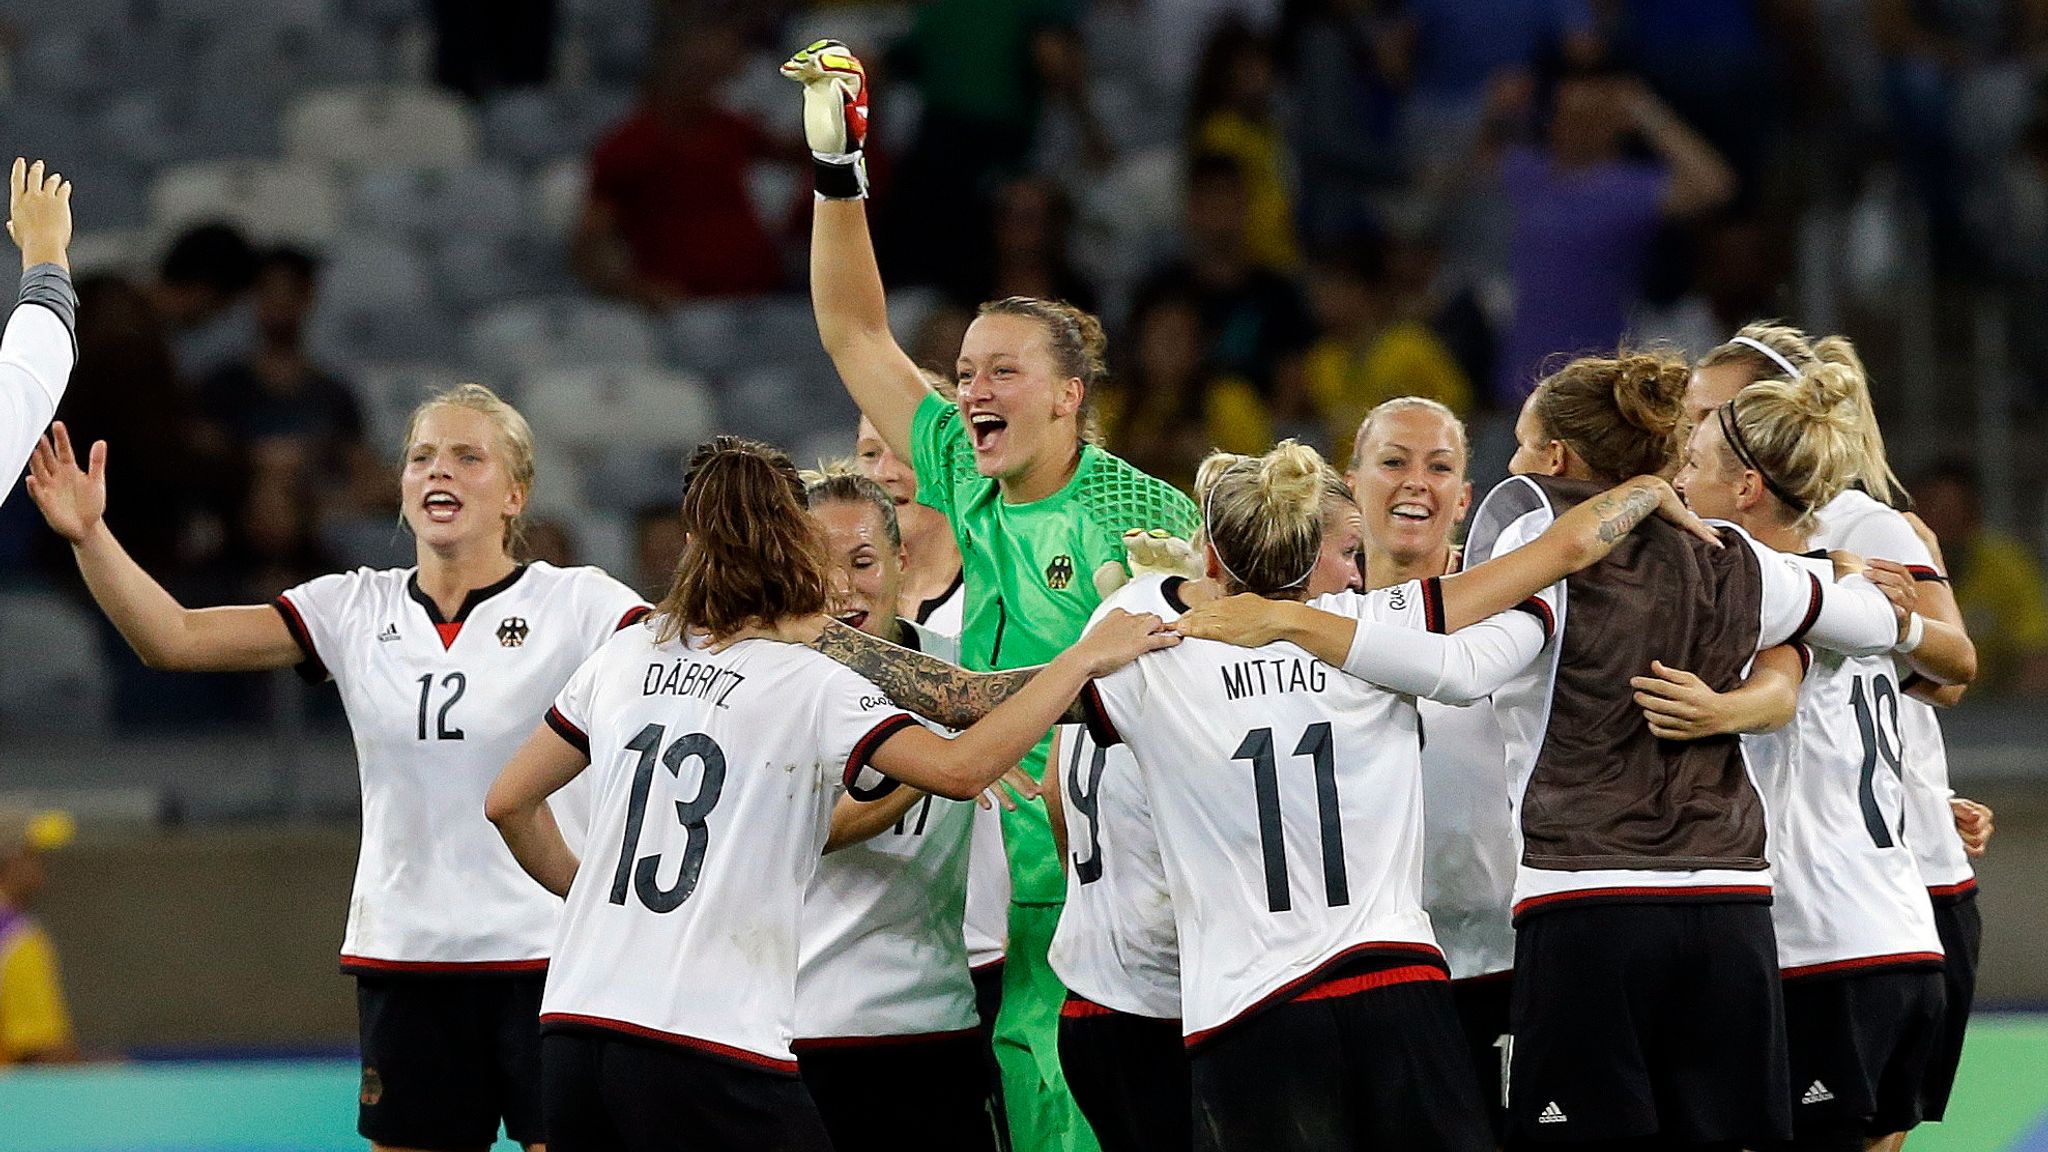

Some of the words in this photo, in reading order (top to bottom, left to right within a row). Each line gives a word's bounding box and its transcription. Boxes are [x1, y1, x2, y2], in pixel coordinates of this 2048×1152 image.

[415, 671, 466, 740] 12
[643, 658, 746, 709] DÄBRITZ
[1220, 658, 1326, 700] MITTAG
[608, 722, 726, 914] 13
[1068, 722, 1107, 886] 9
[1230, 721, 1350, 912] 11
